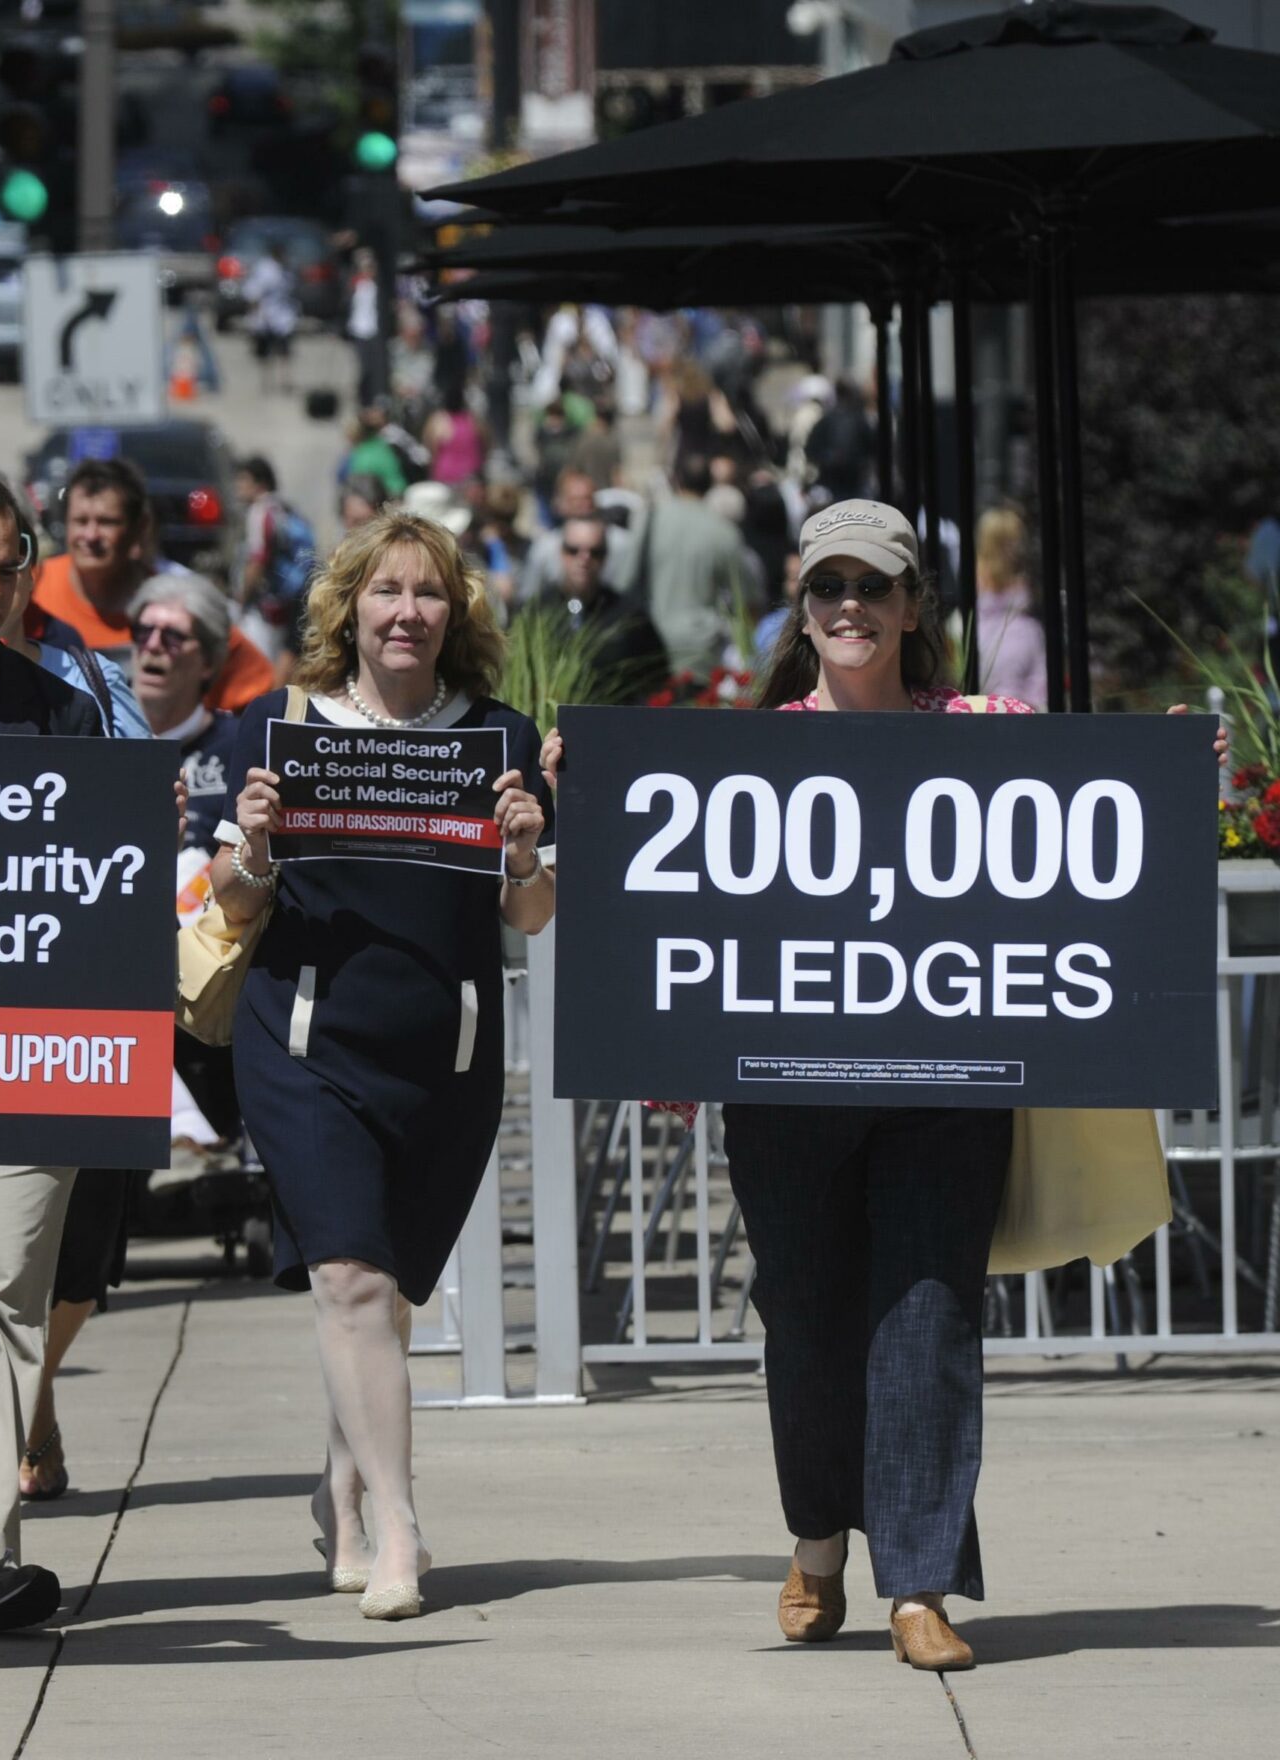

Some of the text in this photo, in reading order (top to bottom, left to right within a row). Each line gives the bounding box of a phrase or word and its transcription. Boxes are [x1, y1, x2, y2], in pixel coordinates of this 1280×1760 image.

[315, 736, 462, 759] Cut Medicare?
[284, 760, 486, 787] Cut Social Security?
[315, 785, 460, 806] Cut Medicaid?
[286, 812, 484, 840] LOSE OUR GRASSROOTS SUPPORT
[624, 772, 1144, 922] 200,000
[656, 937, 1114, 1020] PLEDGES
[745, 1060, 760, 1068] Paid
[760, 1060, 770, 1068] for
[770, 1061, 778, 1070] by
[779, 1061, 789, 1069] the
[790, 1061, 827, 1071] Progressive
[827, 1062, 853, 1071] Change
[853, 1062, 885, 1072] Campaign
[886, 1063, 920, 1071] Committee
[920, 1063, 935, 1071] PAC
[806, 1070, 839, 1078] authorized
[840, 1071, 848, 1079] by
[849, 1071, 860, 1079] any
